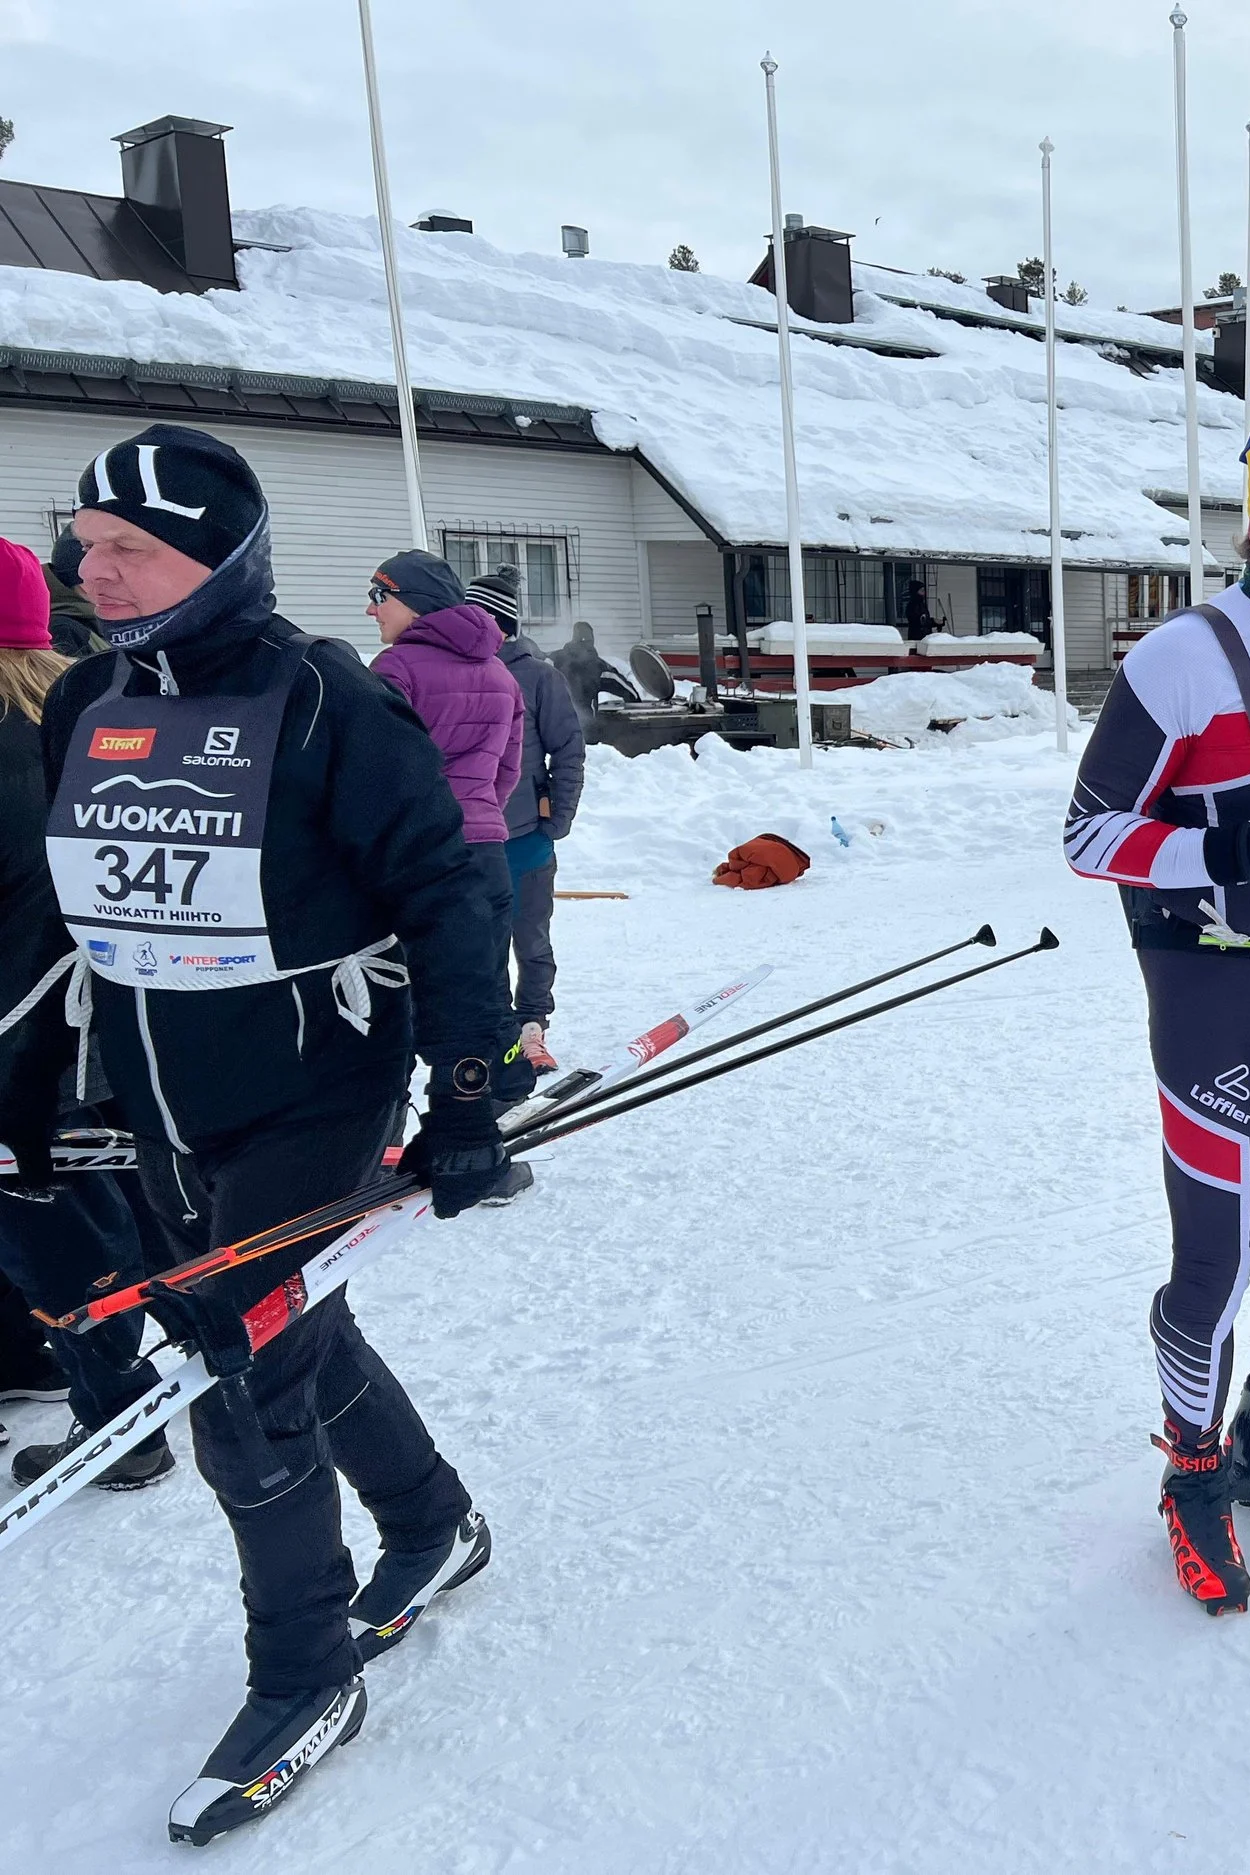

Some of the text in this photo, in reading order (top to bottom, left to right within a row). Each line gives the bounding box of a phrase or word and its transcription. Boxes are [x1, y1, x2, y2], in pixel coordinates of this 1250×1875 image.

[98, 736, 146, 751] START
[73, 803, 242, 836] VUOKATTI
[94, 845, 210, 906] 347
[94, 904, 222, 923] VUOKATTI HIIHTO
[183, 955, 257, 965] INTERSPORT
[694, 982, 749, 1014] REDLINE
[320, 1224, 380, 1271] REDLINE
[251, 1703, 340, 1801] SALOMON
